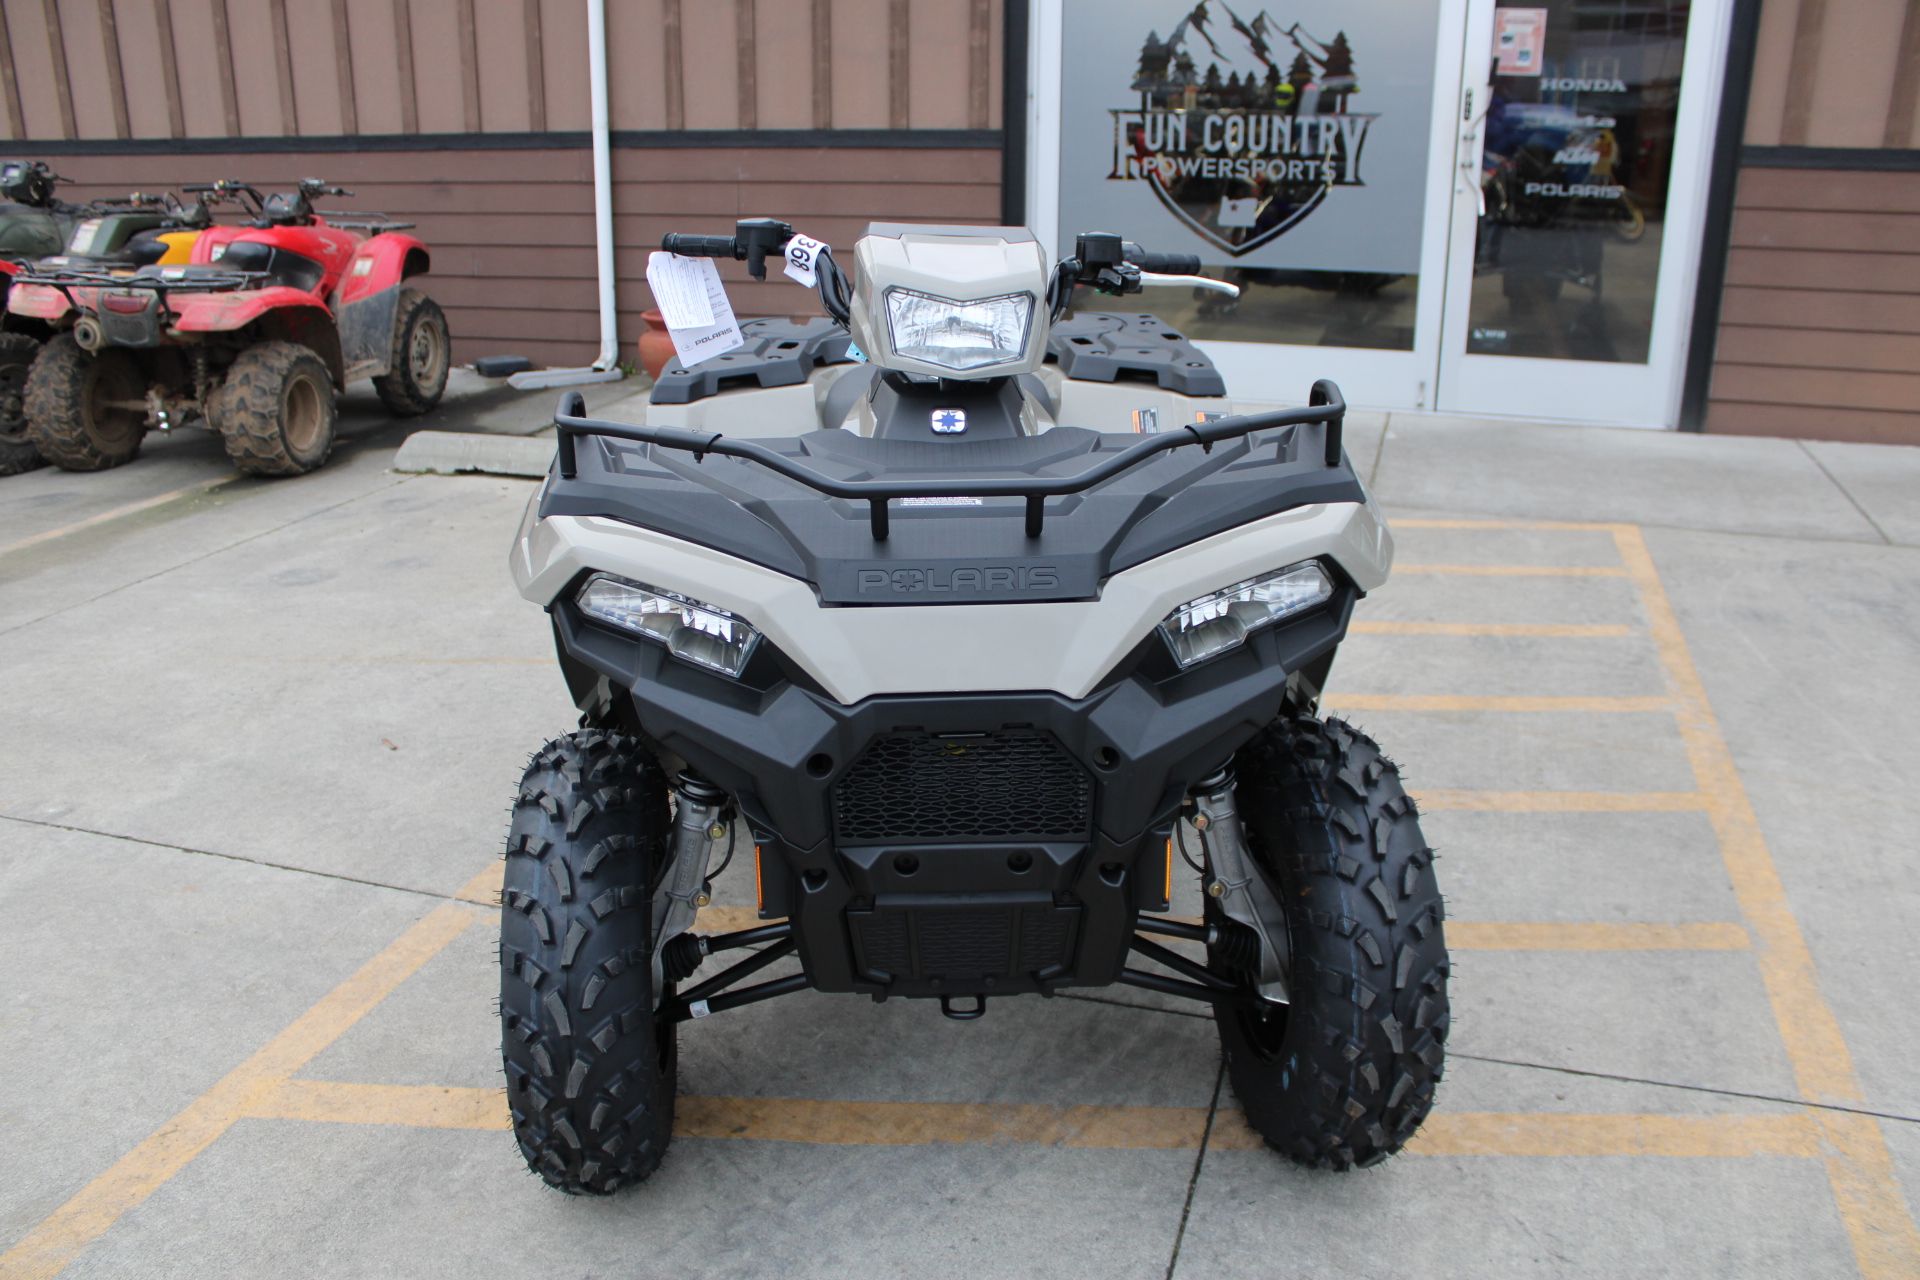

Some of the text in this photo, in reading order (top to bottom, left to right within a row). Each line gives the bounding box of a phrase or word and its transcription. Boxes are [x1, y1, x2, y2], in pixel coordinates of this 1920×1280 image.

[1540, 78, 1627, 92] HONDA
[1109, 111, 1374, 184] FUN COUNTRY
[1141, 157, 1337, 181] POWERSPORTS
[1525, 182, 1624, 199] POLARIS
[790, 237, 817, 272] 368
[694, 327, 733, 346] POLARIS
[857, 566, 1061, 594] POLARIS
